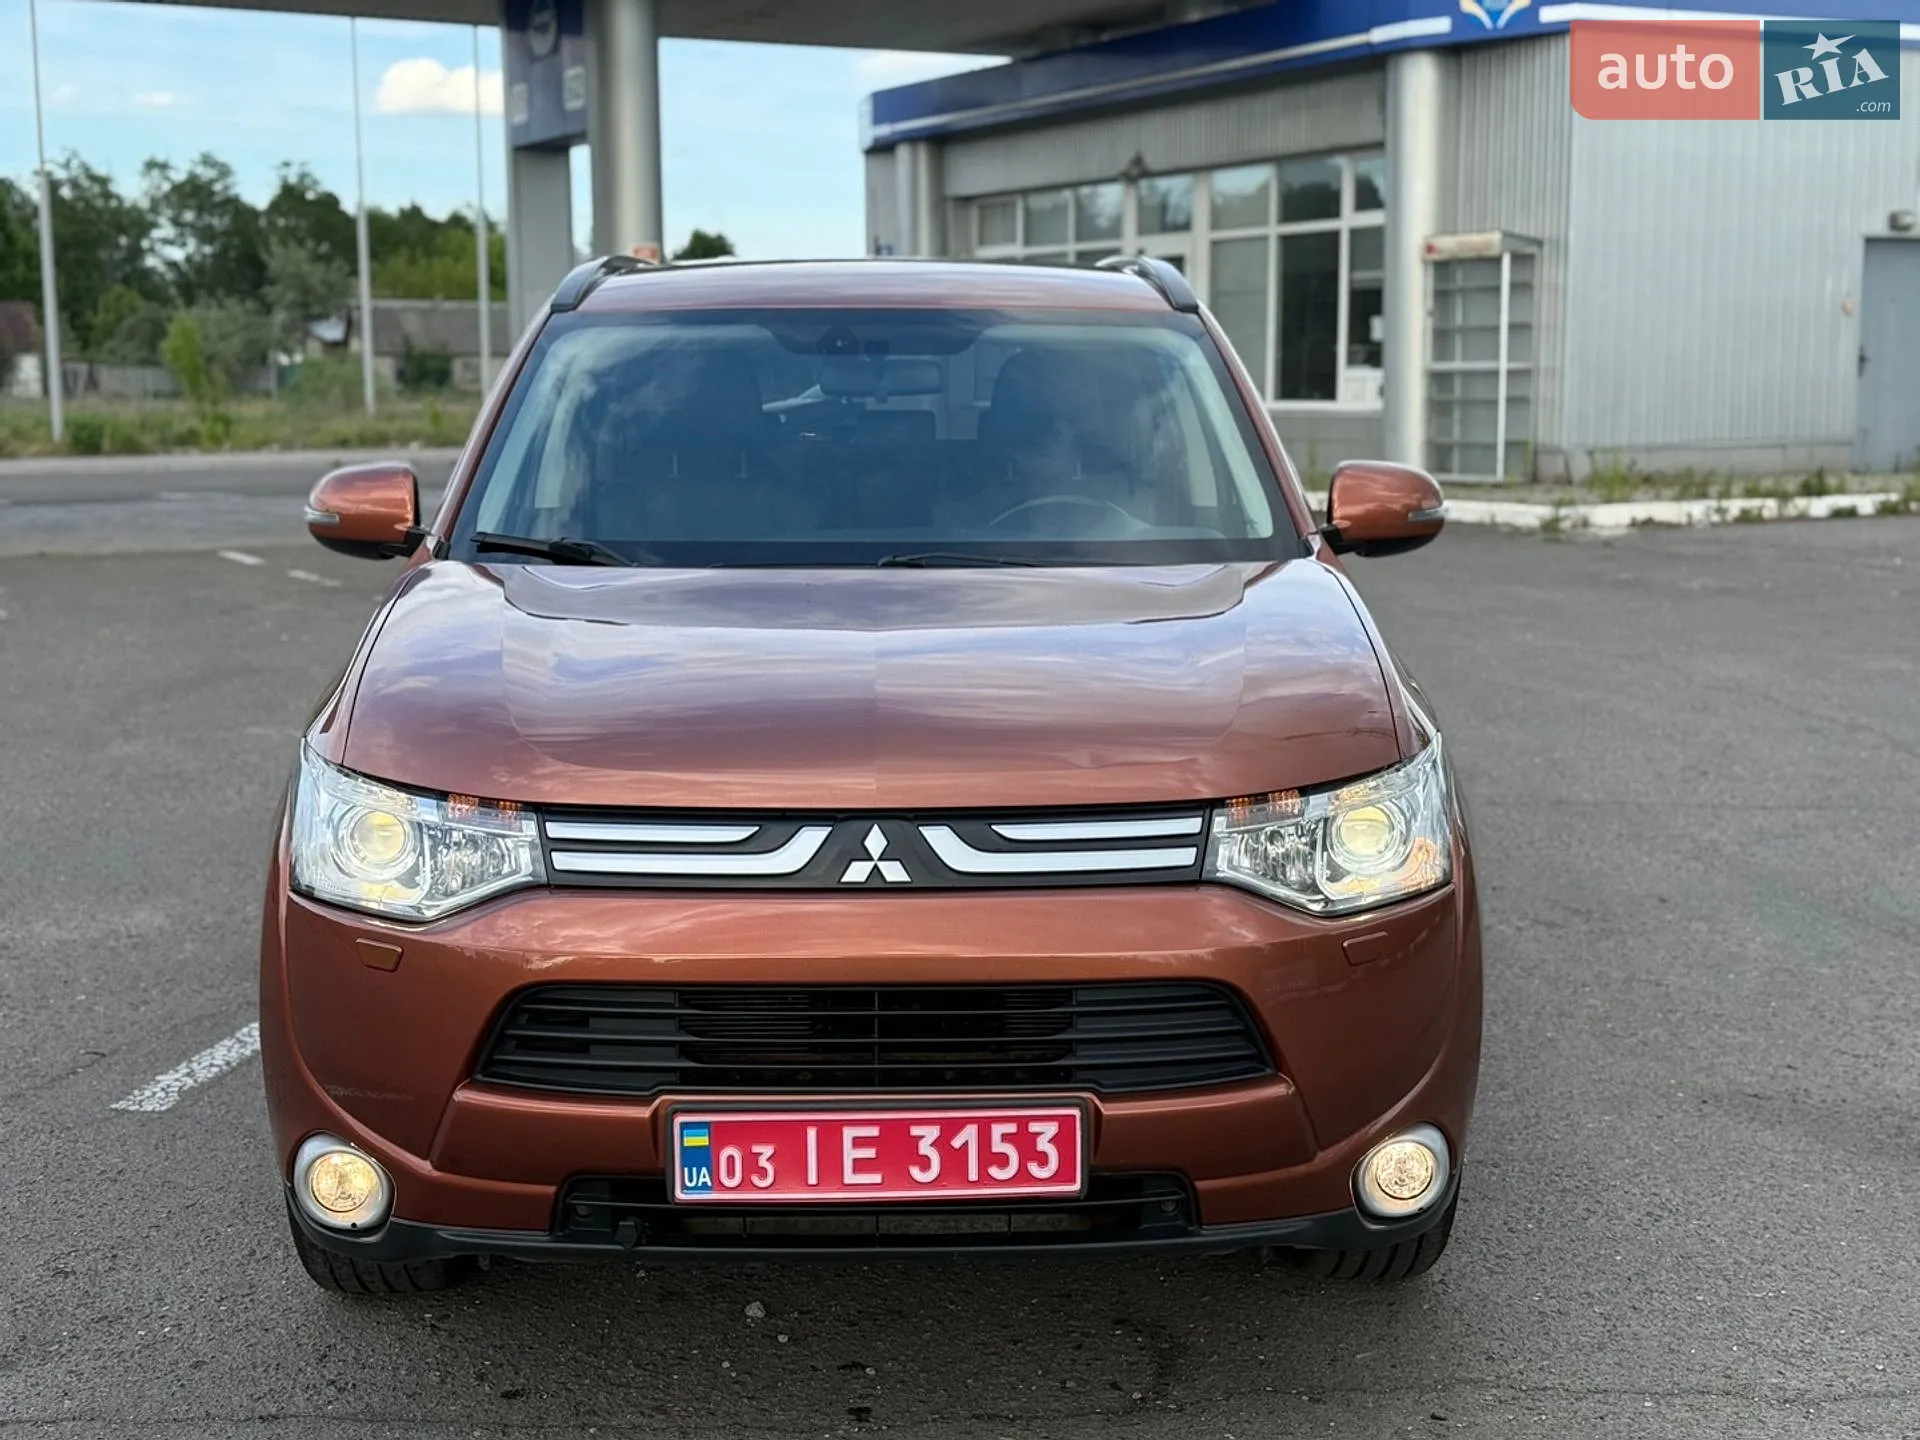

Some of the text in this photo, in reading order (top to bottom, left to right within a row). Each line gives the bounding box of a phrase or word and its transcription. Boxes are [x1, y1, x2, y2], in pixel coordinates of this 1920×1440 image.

[718, 1121, 1060, 1188] 03 IE 3153
[683, 1167, 711, 1187] UA
